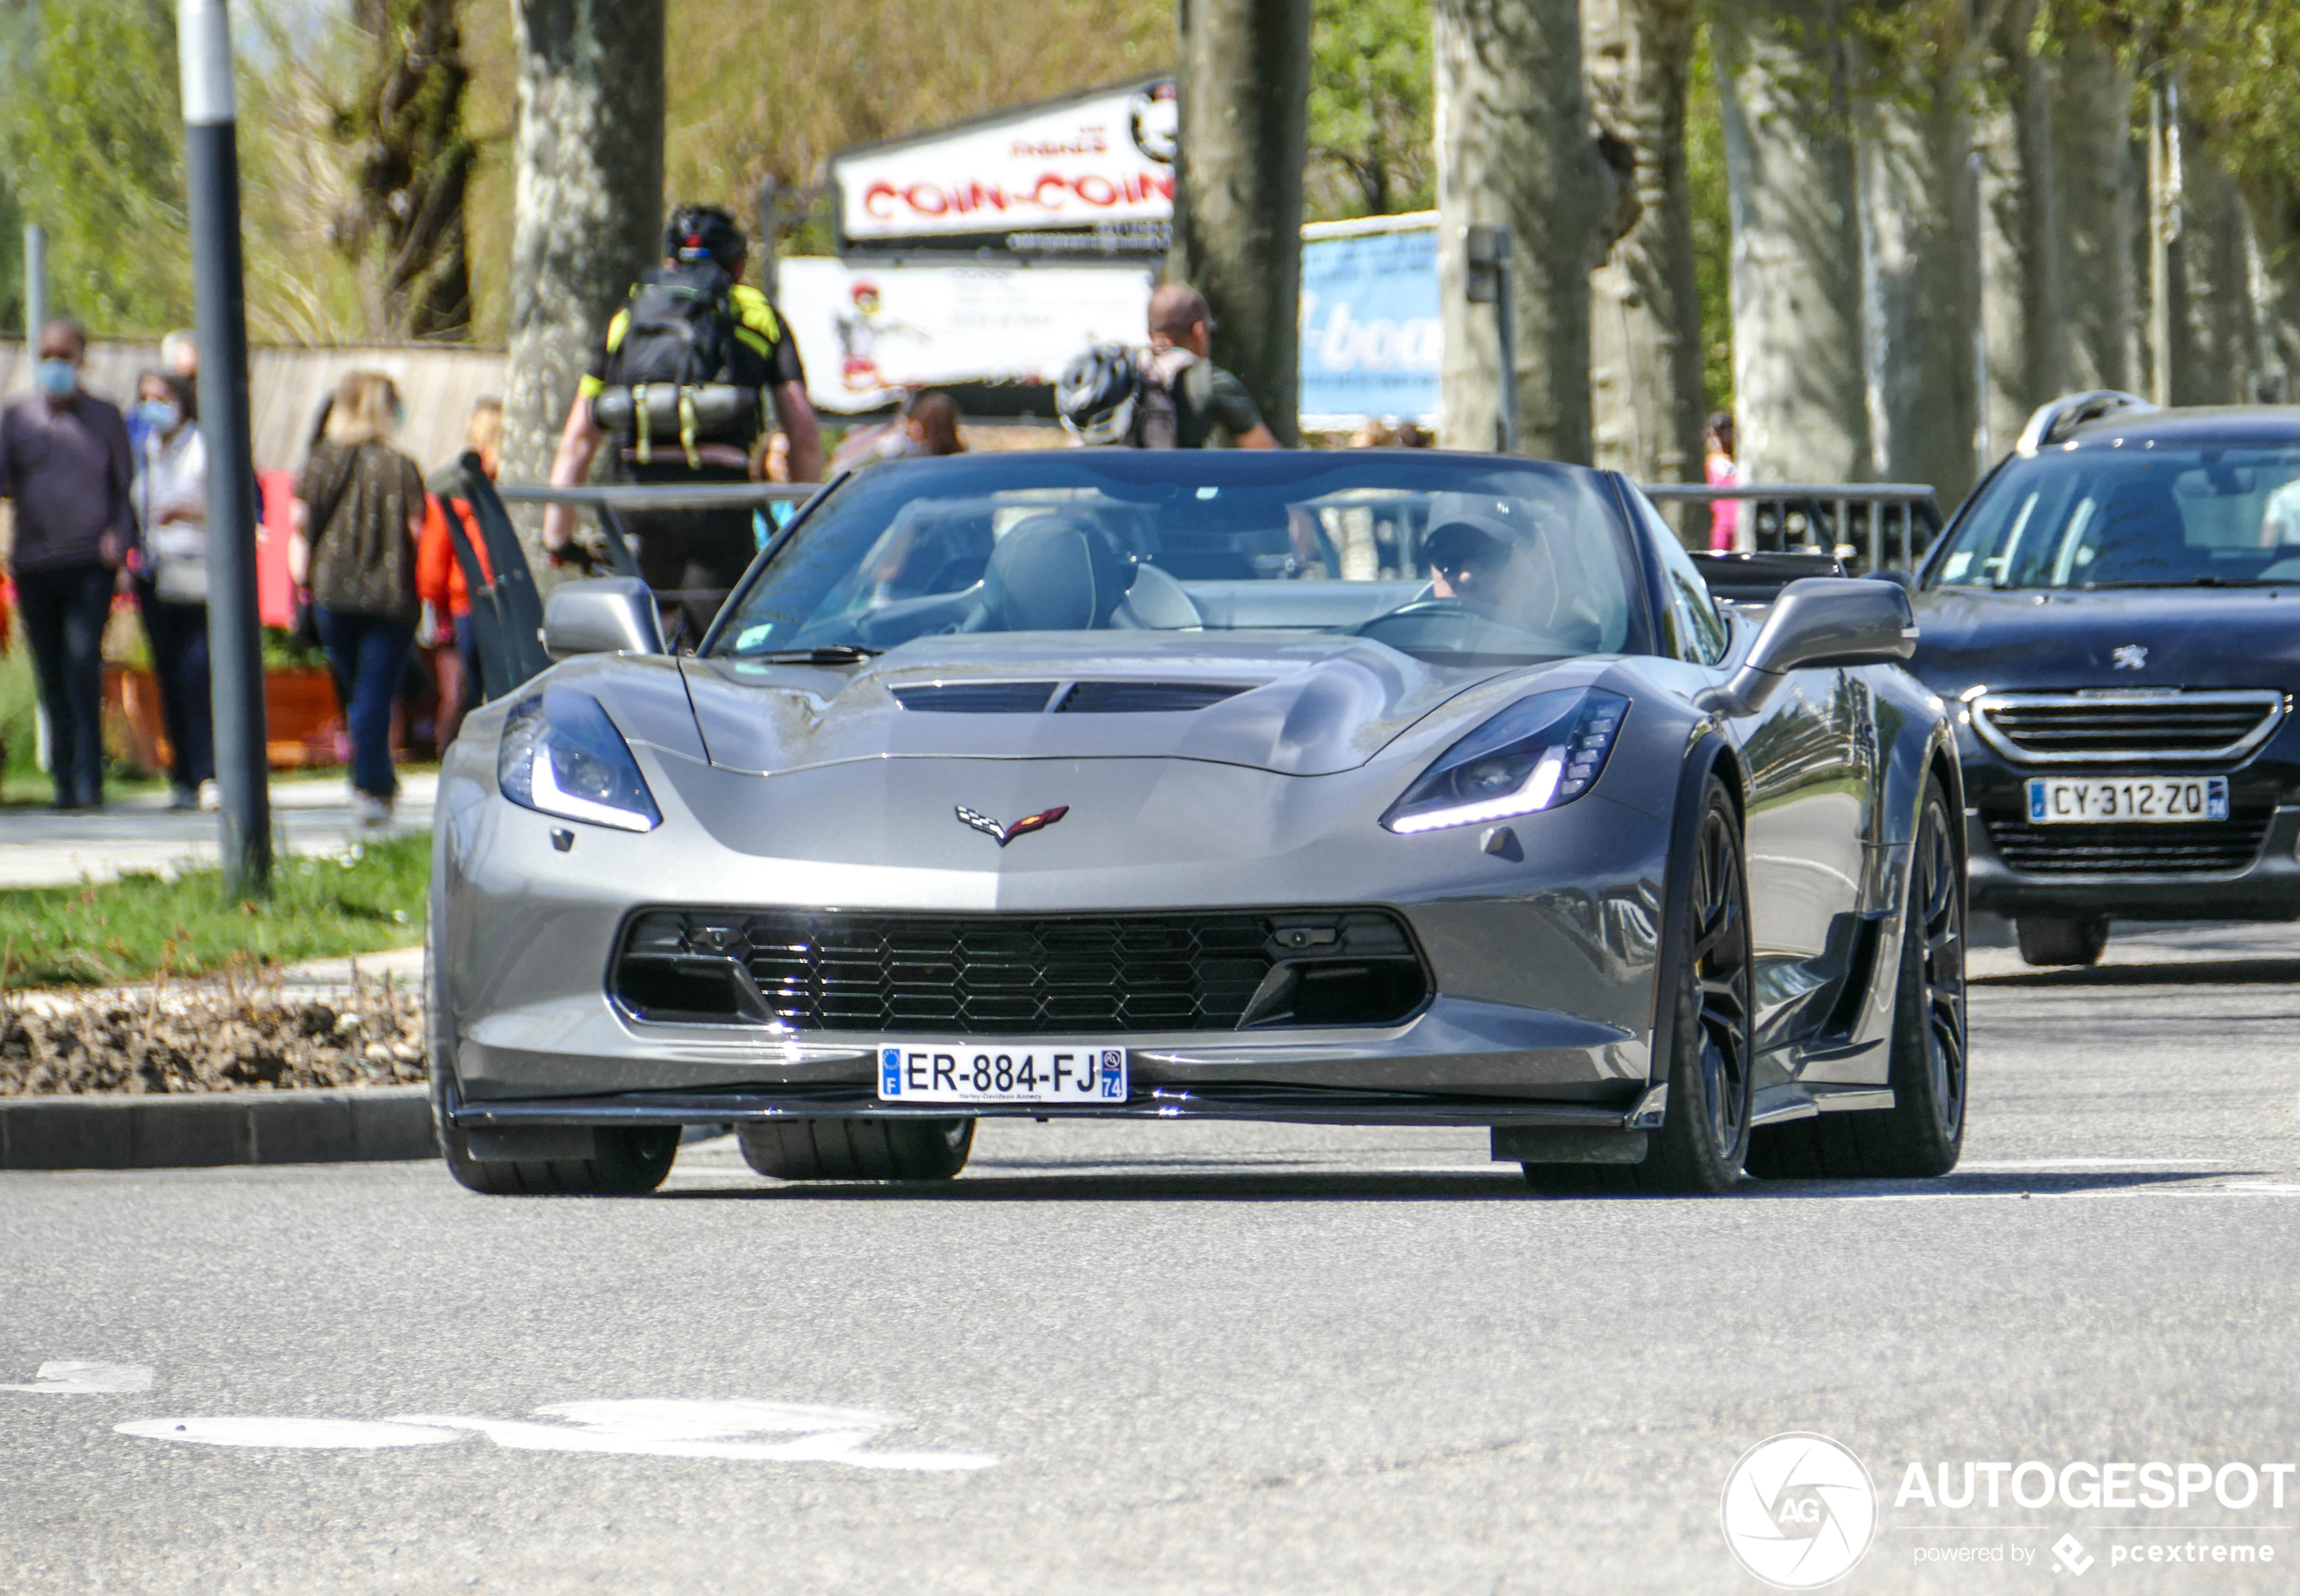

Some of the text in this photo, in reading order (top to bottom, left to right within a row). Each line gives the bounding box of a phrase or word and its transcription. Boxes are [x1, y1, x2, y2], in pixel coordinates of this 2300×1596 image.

[907, 1053, 1095, 1093] ER-884-FJ
[886, 1077, 896, 1094] F
[1103, 1077, 1122, 1097] 74
[1016, 1094, 1042, 1102] Annecy
